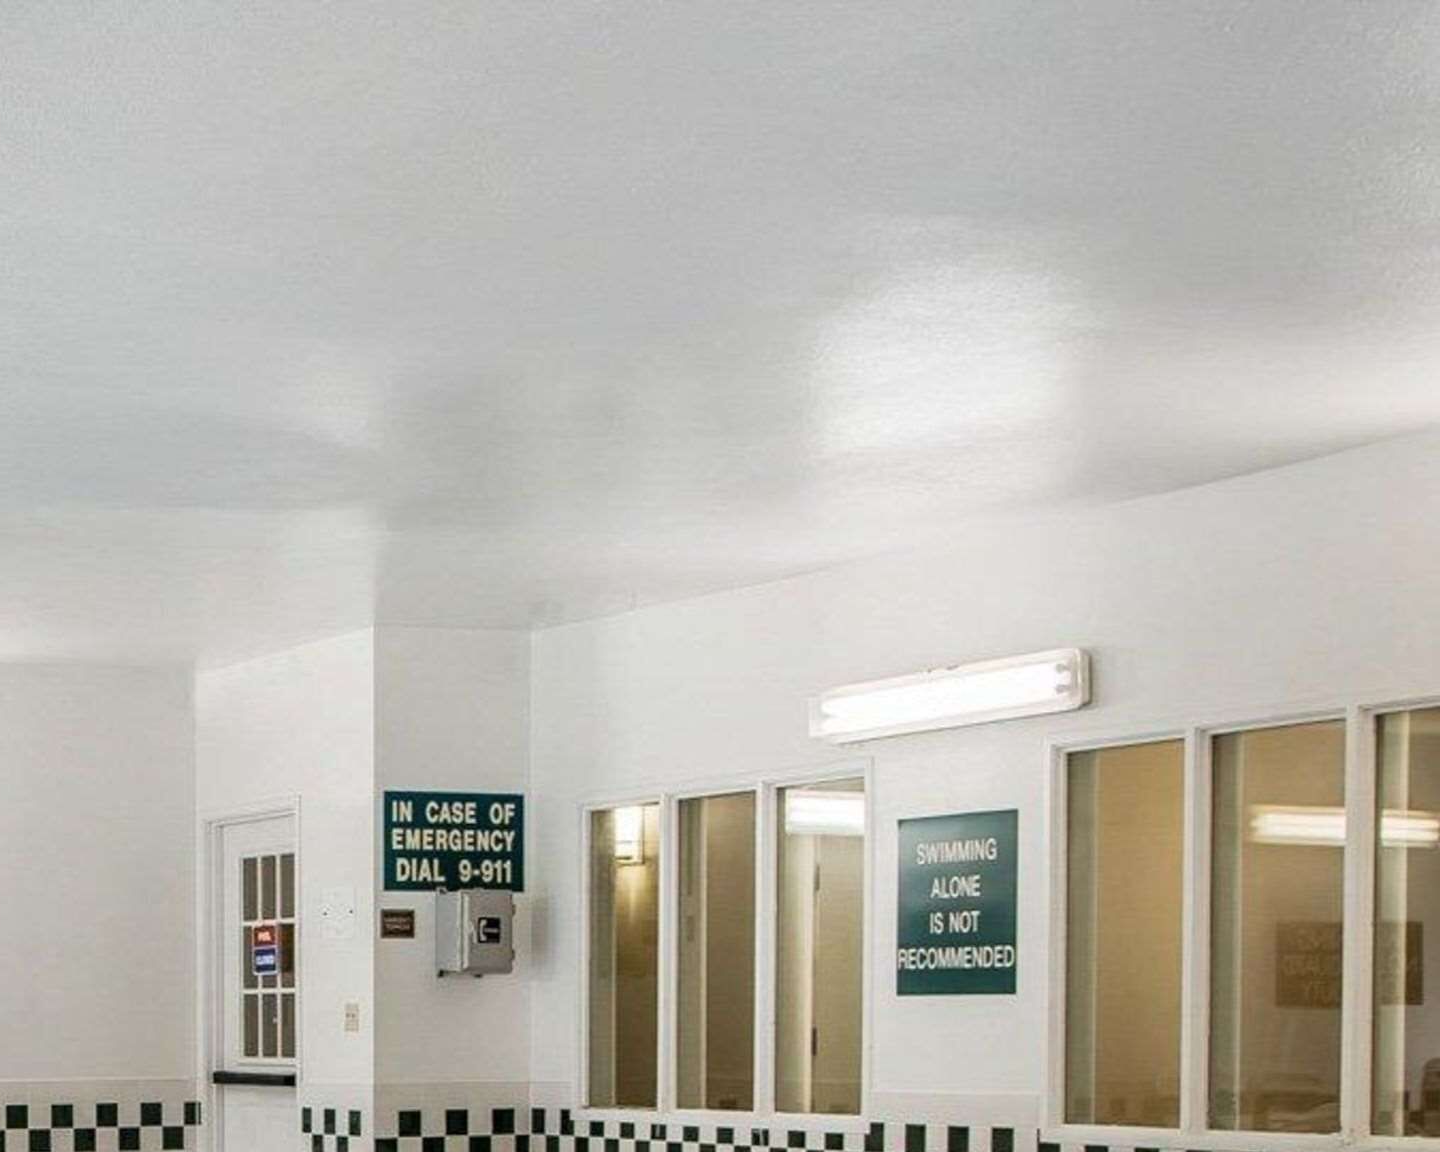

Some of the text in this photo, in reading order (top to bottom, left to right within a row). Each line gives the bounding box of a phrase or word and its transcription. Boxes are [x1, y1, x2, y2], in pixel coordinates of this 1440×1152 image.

[391, 801, 516, 825] IN CASE OF
[392, 828, 516, 852] EMERGENCY
[915, 837, 998, 864] SWIMMING
[395, 857, 512, 883] DIAL 9-911
[930, 875, 981, 899] ALONE
[929, 910, 981, 934] IS NOT
[898, 945, 1015, 970] RECOMMENDED
